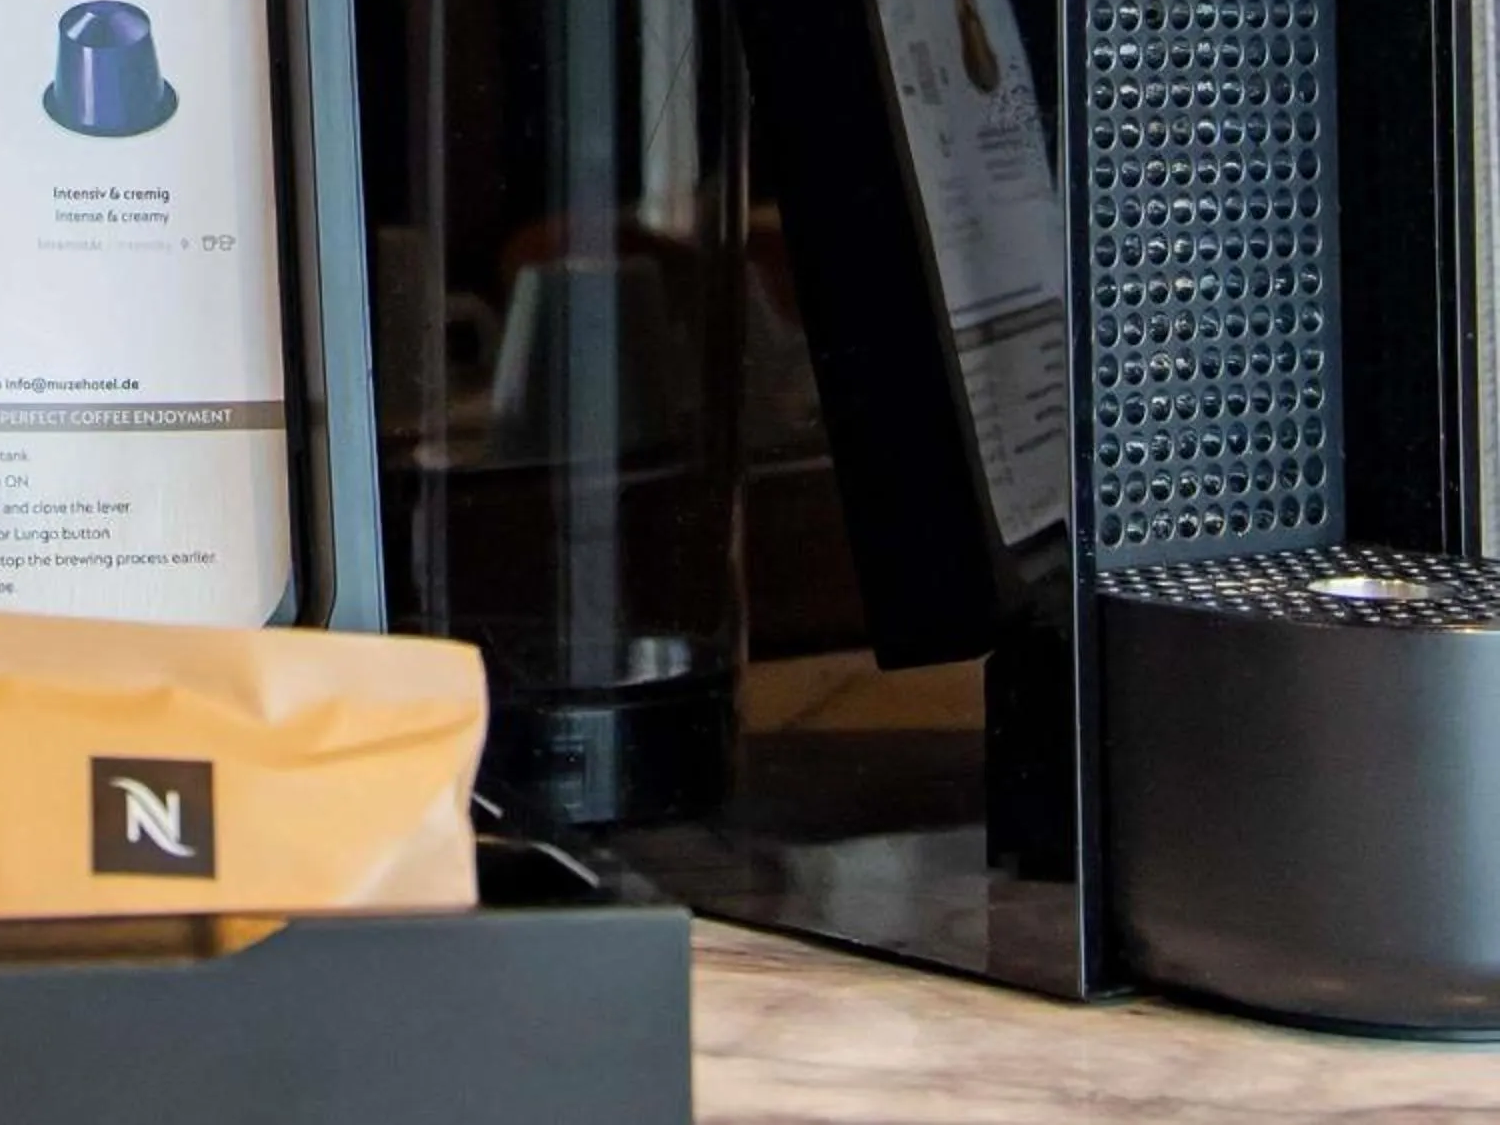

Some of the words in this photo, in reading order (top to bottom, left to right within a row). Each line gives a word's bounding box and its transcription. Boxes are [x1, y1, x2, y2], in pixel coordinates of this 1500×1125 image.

[53, 186, 106, 200] Intensiv
[123, 187, 171, 203] cremig
[55, 209, 104, 223] Intense
[121, 211, 169, 225] creamy
[0, 410, 68, 425] PERFECT
[71, 409, 132, 425] COFFEE
[135, 408, 234, 424] ENJOYMENT
[3, 501, 29, 515] and
[70, 500, 94, 514] the
[14, 527, 59, 544] Lungo
[28, 554, 52, 567] the
[55, 553, 113, 569] brewing
[116, 554, 169, 569] process
[111, 777, 196, 857] N
